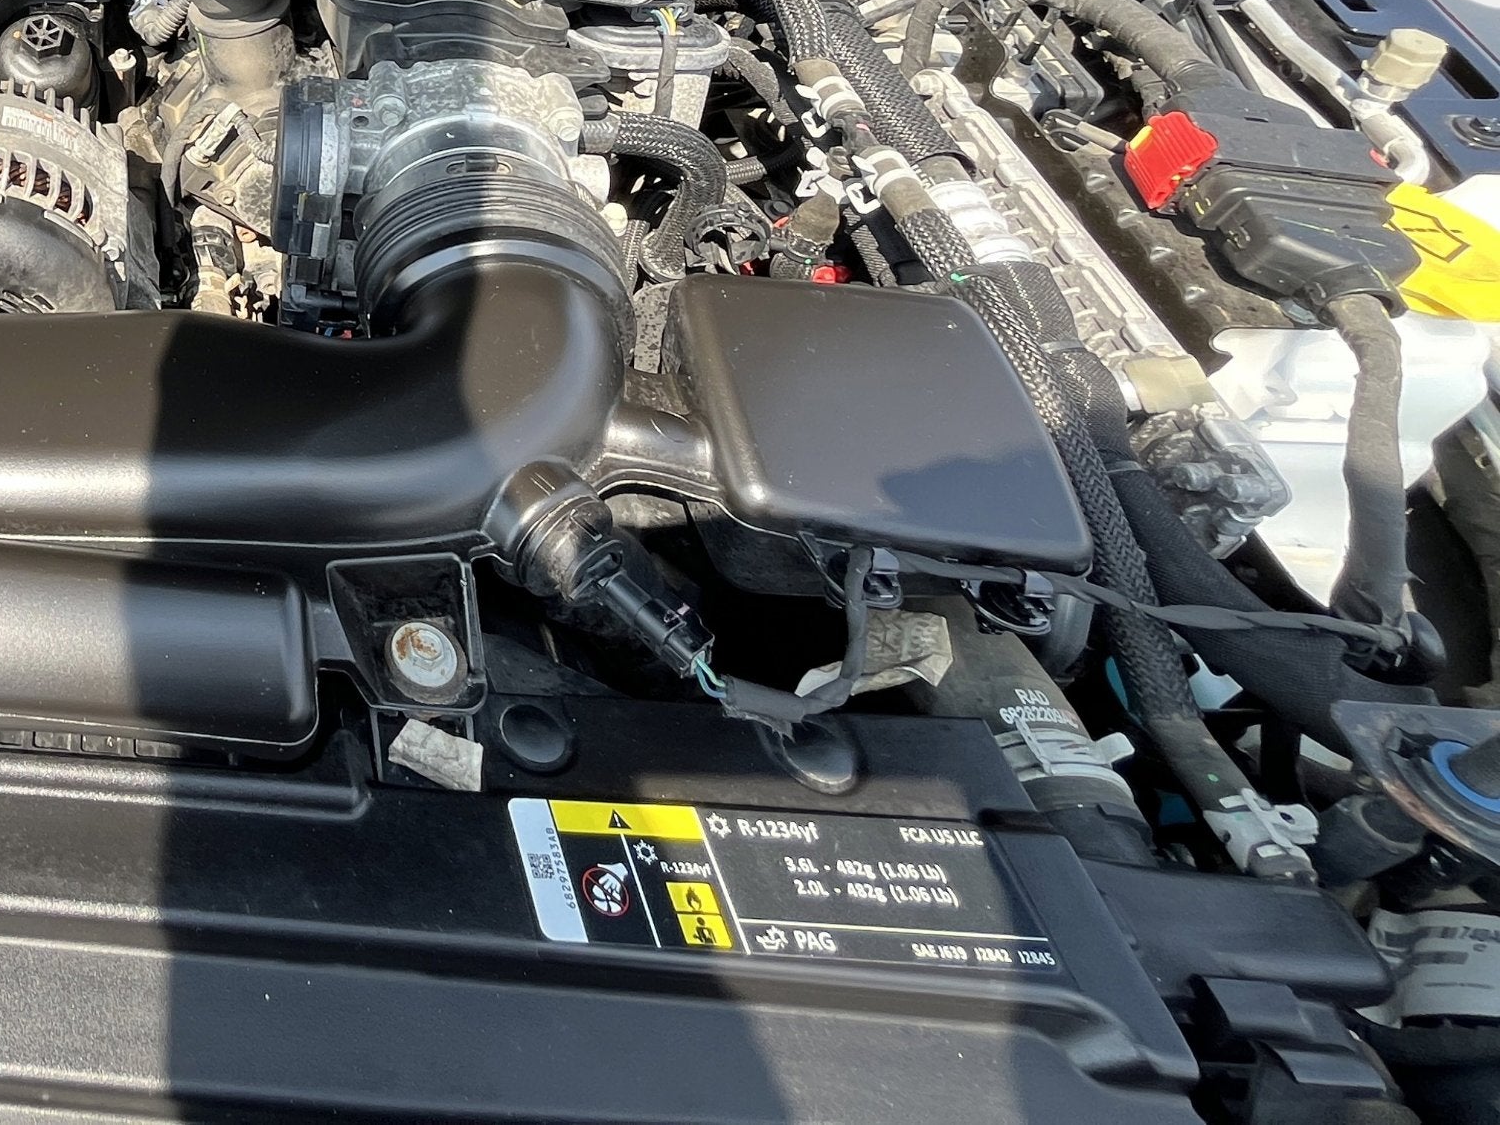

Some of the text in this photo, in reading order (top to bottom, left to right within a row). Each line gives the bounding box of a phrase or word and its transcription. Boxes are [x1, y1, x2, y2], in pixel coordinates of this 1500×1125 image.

[1014, 688, 1049, 705] RAD
[737, 819, 819, 843] R-1234yf
[900, 827, 984, 846] FCA US LLC
[546, 827, 576, 909] 68297583AB
[660, 861, 712, 878] R-1234yf
[784, 856, 819, 873] 3.6L
[836, 859, 876, 879] 482g
[878, 862, 919, 880] (1.06
[918, 864, 947, 884] Lb)
[794, 879, 829, 896] 2.0L
[847, 882, 887, 903] 482g
[889, 884, 931, 903] (1.06
[930, 887, 959, 908] Lb)
[793, 930, 836, 952] PAG
[911, 943, 939, 958] SAE
